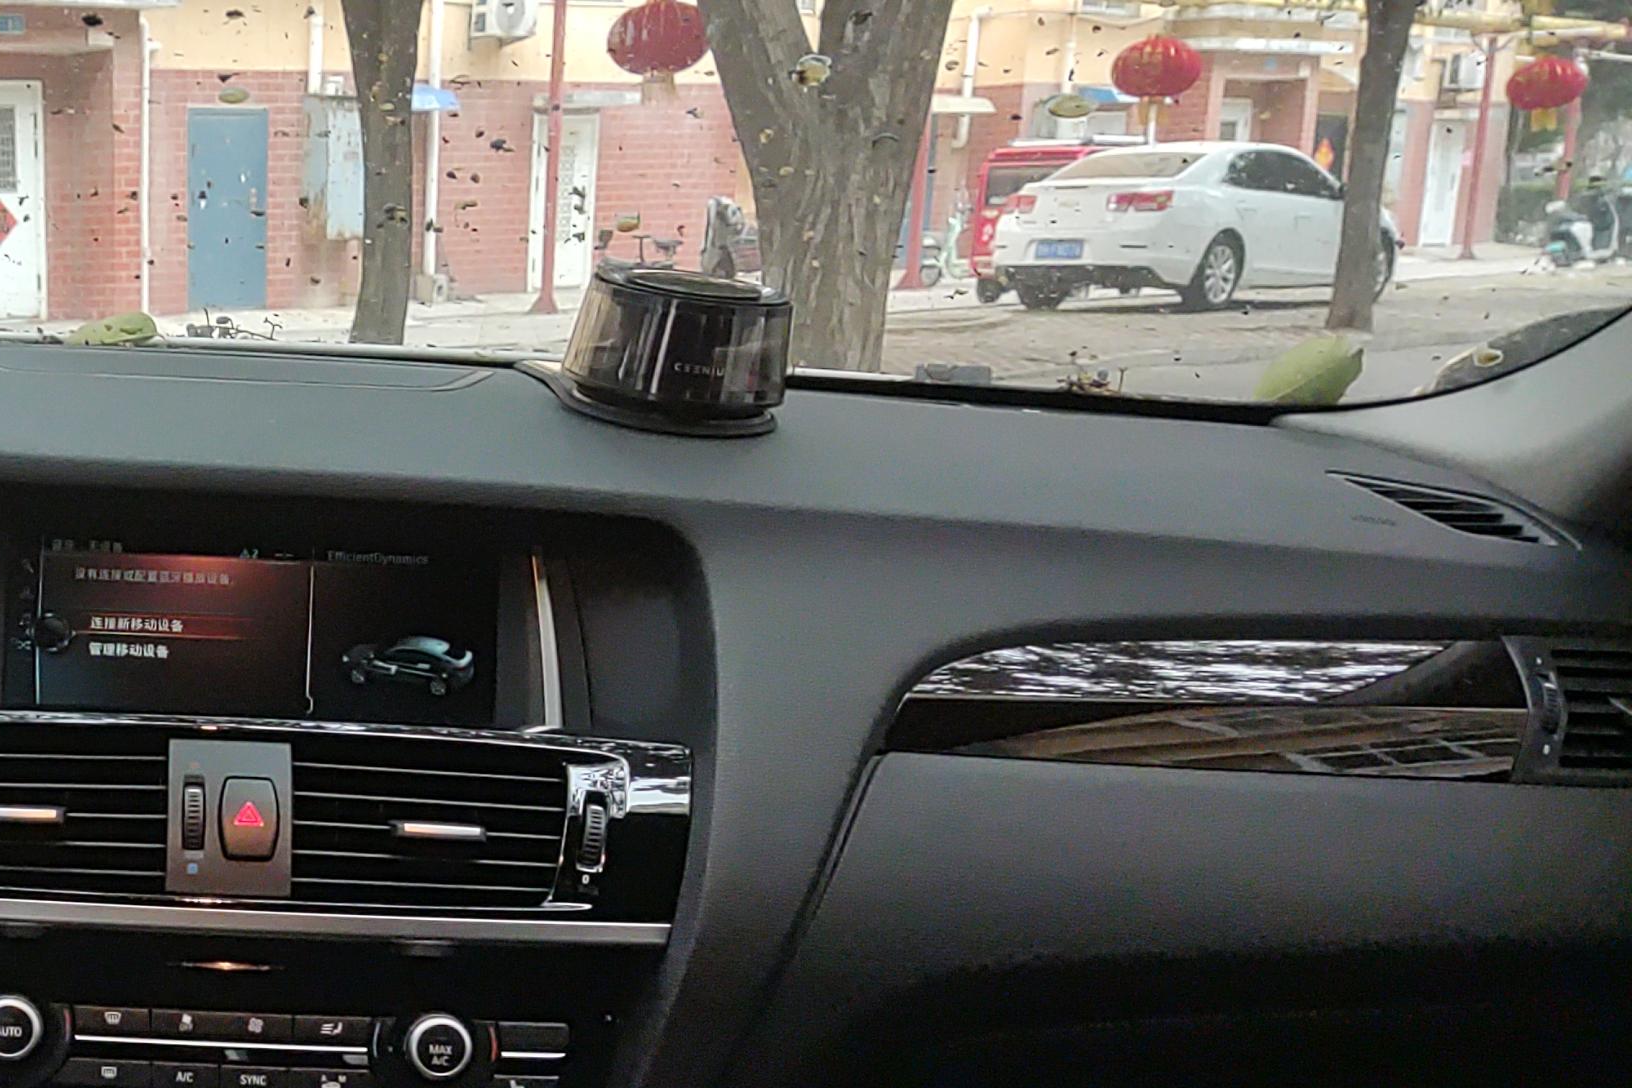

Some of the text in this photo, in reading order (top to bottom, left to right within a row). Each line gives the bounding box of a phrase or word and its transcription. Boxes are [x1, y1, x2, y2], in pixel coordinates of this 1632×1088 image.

[429, 1044, 452, 1056] MAX
[431, 1055, 449, 1067] A/C
[176, 1071, 194, 1084] A/C
[239, 1074, 267, 1087] SYNC
